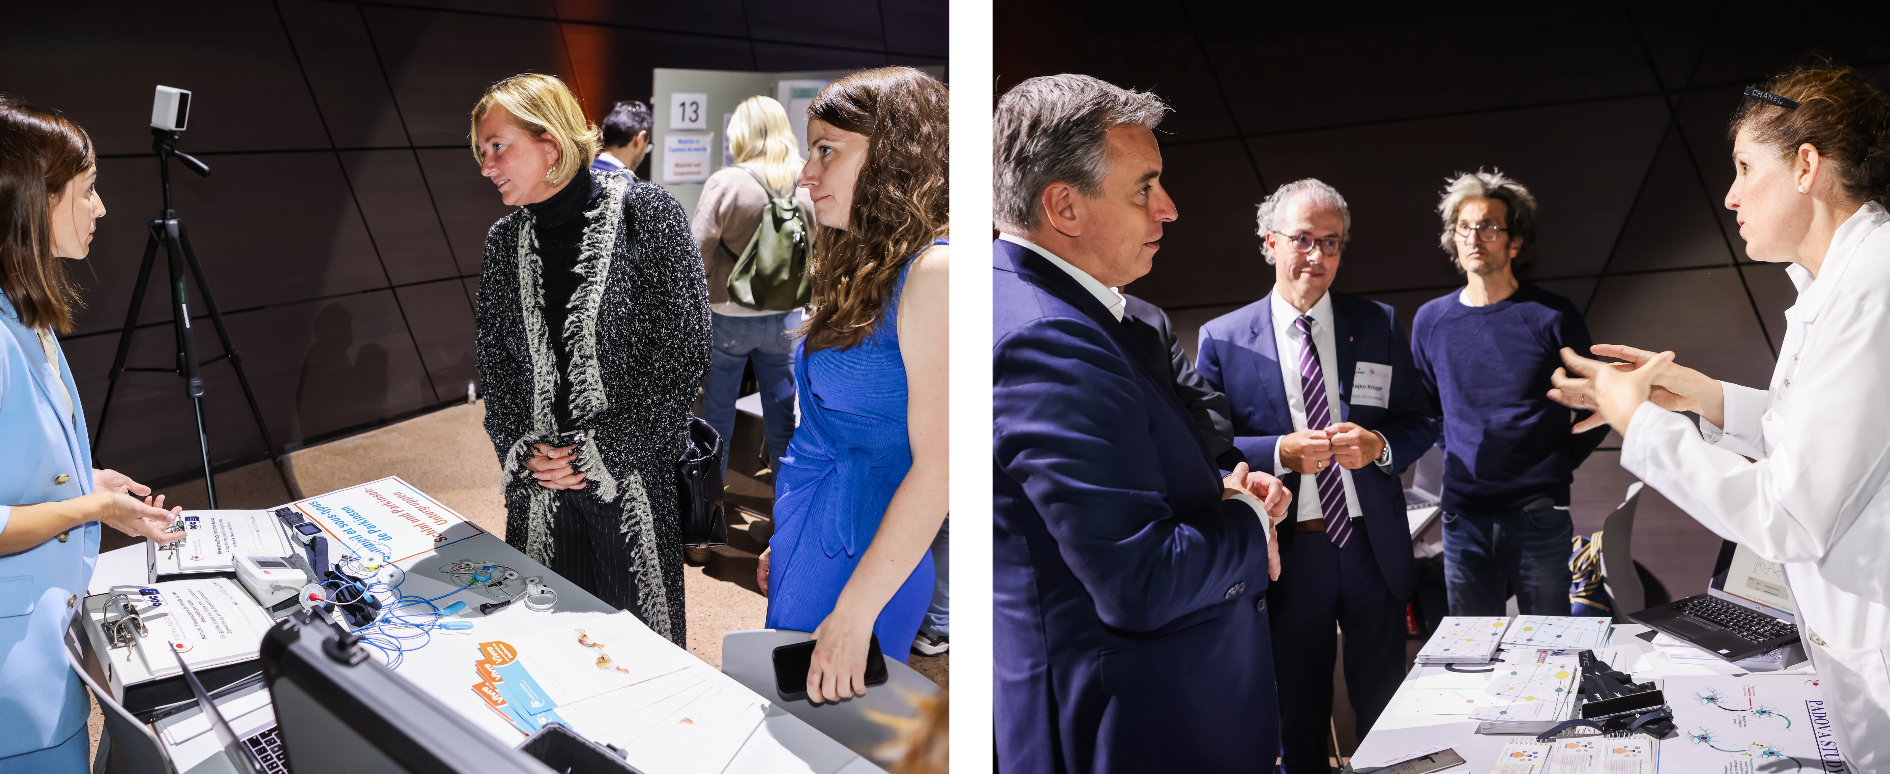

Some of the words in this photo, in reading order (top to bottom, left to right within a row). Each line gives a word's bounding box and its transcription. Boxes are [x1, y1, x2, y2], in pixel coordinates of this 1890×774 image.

[1752, 89, 1783, 105] CHANEL
[679, 101, 699, 123] 13
[309, 500, 348, 528] sous-types
[393, 491, 448, 526] Untergruppen
[398, 513, 421, 523] und
[341, 506, 382, 534] Parkinson
[342, 527, 357, 535] et
[378, 532, 393, 541] de
[413, 522, 448, 543] Schlaf
[487, 647, 503, 664] Vivre
[484, 663, 501, 681] Vivre
[482, 686, 503, 704] Vivre
[1809, 700, 1833, 738] PADOVA
[1820, 740, 1845, 774] STUDY
